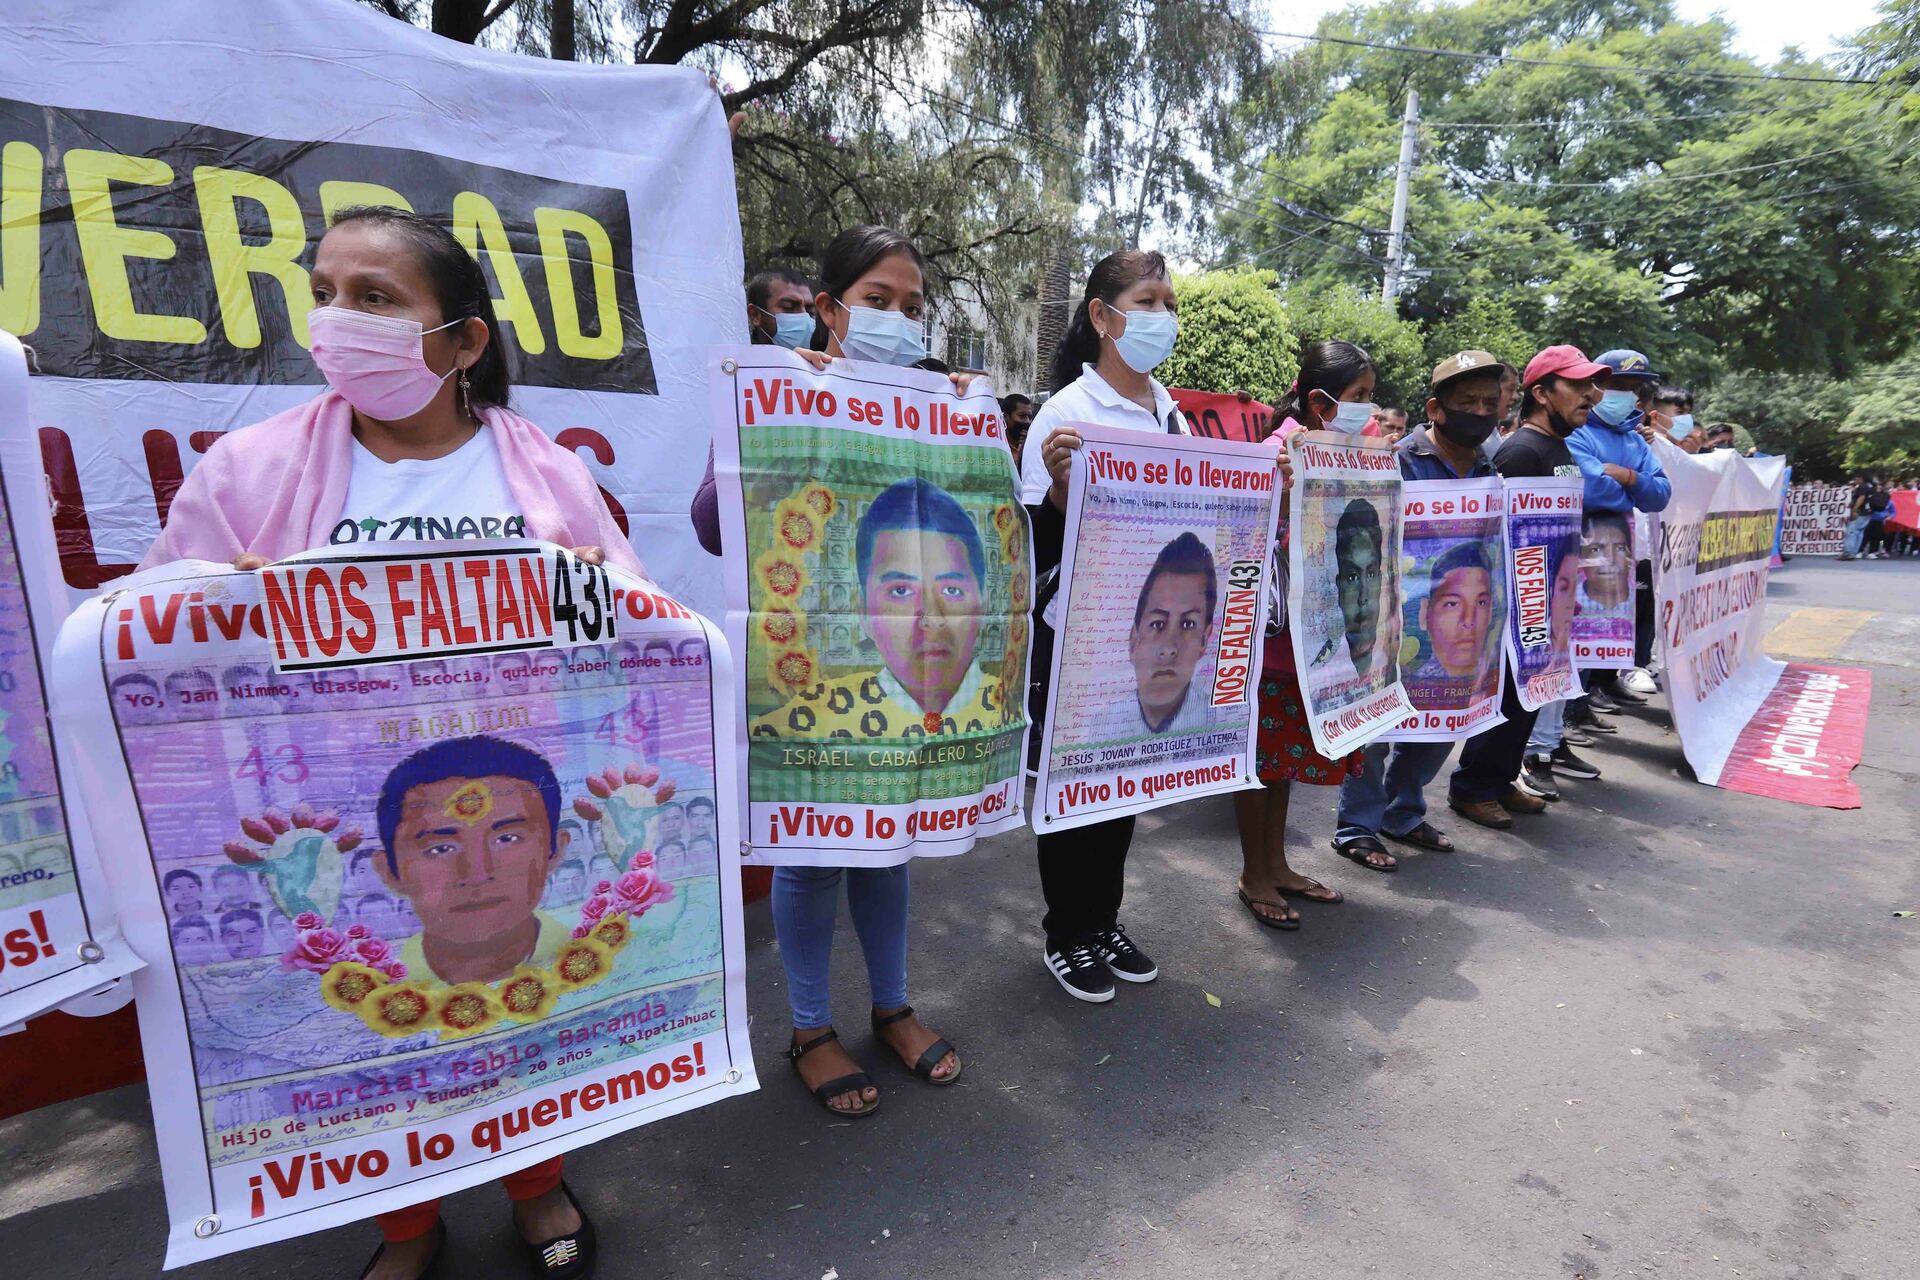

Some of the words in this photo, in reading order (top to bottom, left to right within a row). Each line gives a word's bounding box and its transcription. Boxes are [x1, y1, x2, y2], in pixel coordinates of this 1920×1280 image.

[0, 141, 624, 360] ERAD
[1456, 353, 1476, 368] LA
[743, 378, 837, 425] ¡Vivo
[847, 397, 883, 426] se
[893, 396, 920, 431] lo
[929, 402, 1003, 441] lleva
[1088, 450, 1137, 485] ¡Vivo
[1143, 462, 1168, 485] se
[1175, 458, 1193, 487] lo
[1199, 461, 1276, 492] llevaron!
[1302, 444, 1333, 470] ¡Vivo
[1334, 450, 1347, 468] se
[1346, 449, 1358, 469] lo
[1142, 498, 1169, 510] Glasgow,
[1172, 500, 1202, 510] Escocia,
[1431, 500, 1455, 514] se
[1461, 495, 1480, 513] lo
[1512, 492, 1552, 513] ¡Vivo
[1557, 496, 1571, 509] se
[1796, 542, 1845, 554] REBELDES
[1801, 530, 1845, 542] MUNDO
[1516, 546, 1545, 576] NOS
[262, 565, 377, 660] NOS
[385, 557, 553, 650] FALTAN
[553, 550, 616, 642] 43!
[1518, 577, 1546, 627] FALTAN
[1220, 590, 1256, 660] FALTAN
[1575, 643, 1590, 657] lo
[1596, 646, 1634, 660] quer
[125, 693, 165, 709] Yo,
[180, 689, 219, 705] Jan
[230, 683, 300, 700] Nimmo,
[311, 675, 400, 696] Glasgow,
[412, 669, 491, 687] Escocia,
[502, 664, 560, 682] quiero
[567, 660, 611, 674] saber
[619, 655, 661, 669] dónde
[664, 653, 703, 667] está
[1214, 665, 1247, 705] NOS
[1444, 686, 1476, 697] FRANC
[594, 707, 650, 746] 43
[1394, 717, 1419, 730] vo
[1424, 713, 1441, 729] lo
[236, 743, 310, 787] 43
[783, 748, 854, 767] ISRAEL
[867, 745, 967, 767] CABALLERO
[1061, 751, 1094, 767] JESÚS
[1100, 748, 1136, 762] JOVANY
[1141, 738, 1192, 755] RODRÍGUEZ
[1058, 780, 1111, 815] ¡Vivo
[1117, 775, 1136, 799] lo
[1141, 757, 1237, 799] queremos!
[769, 806, 854, 844] ¡Vivo
[865, 809, 896, 839] lo
[906, 782, 1009, 840] quereos!
[292, 1067, 432, 1114] Marcial
[451, 1042, 543, 1082] Pablo
[557, 1001, 667, 1048] Baranda
[222, 1127, 272, 1148] Hijo
[283, 1120, 307, 1135] de
[318, 1102, 397, 1128] Luciano
[406, 1098, 417, 1112] y
[427, 1076, 500, 1105] Eudocia
[528, 1060, 548, 1075] 20
[556, 1046, 593, 1067] años
[618, 1008, 717, 1047] Xalpatlahuac
[248, 1149, 390, 1219] ¡Vivo
[405, 1130, 456, 1168] lo
[471, 1041, 706, 1154] queremos!
